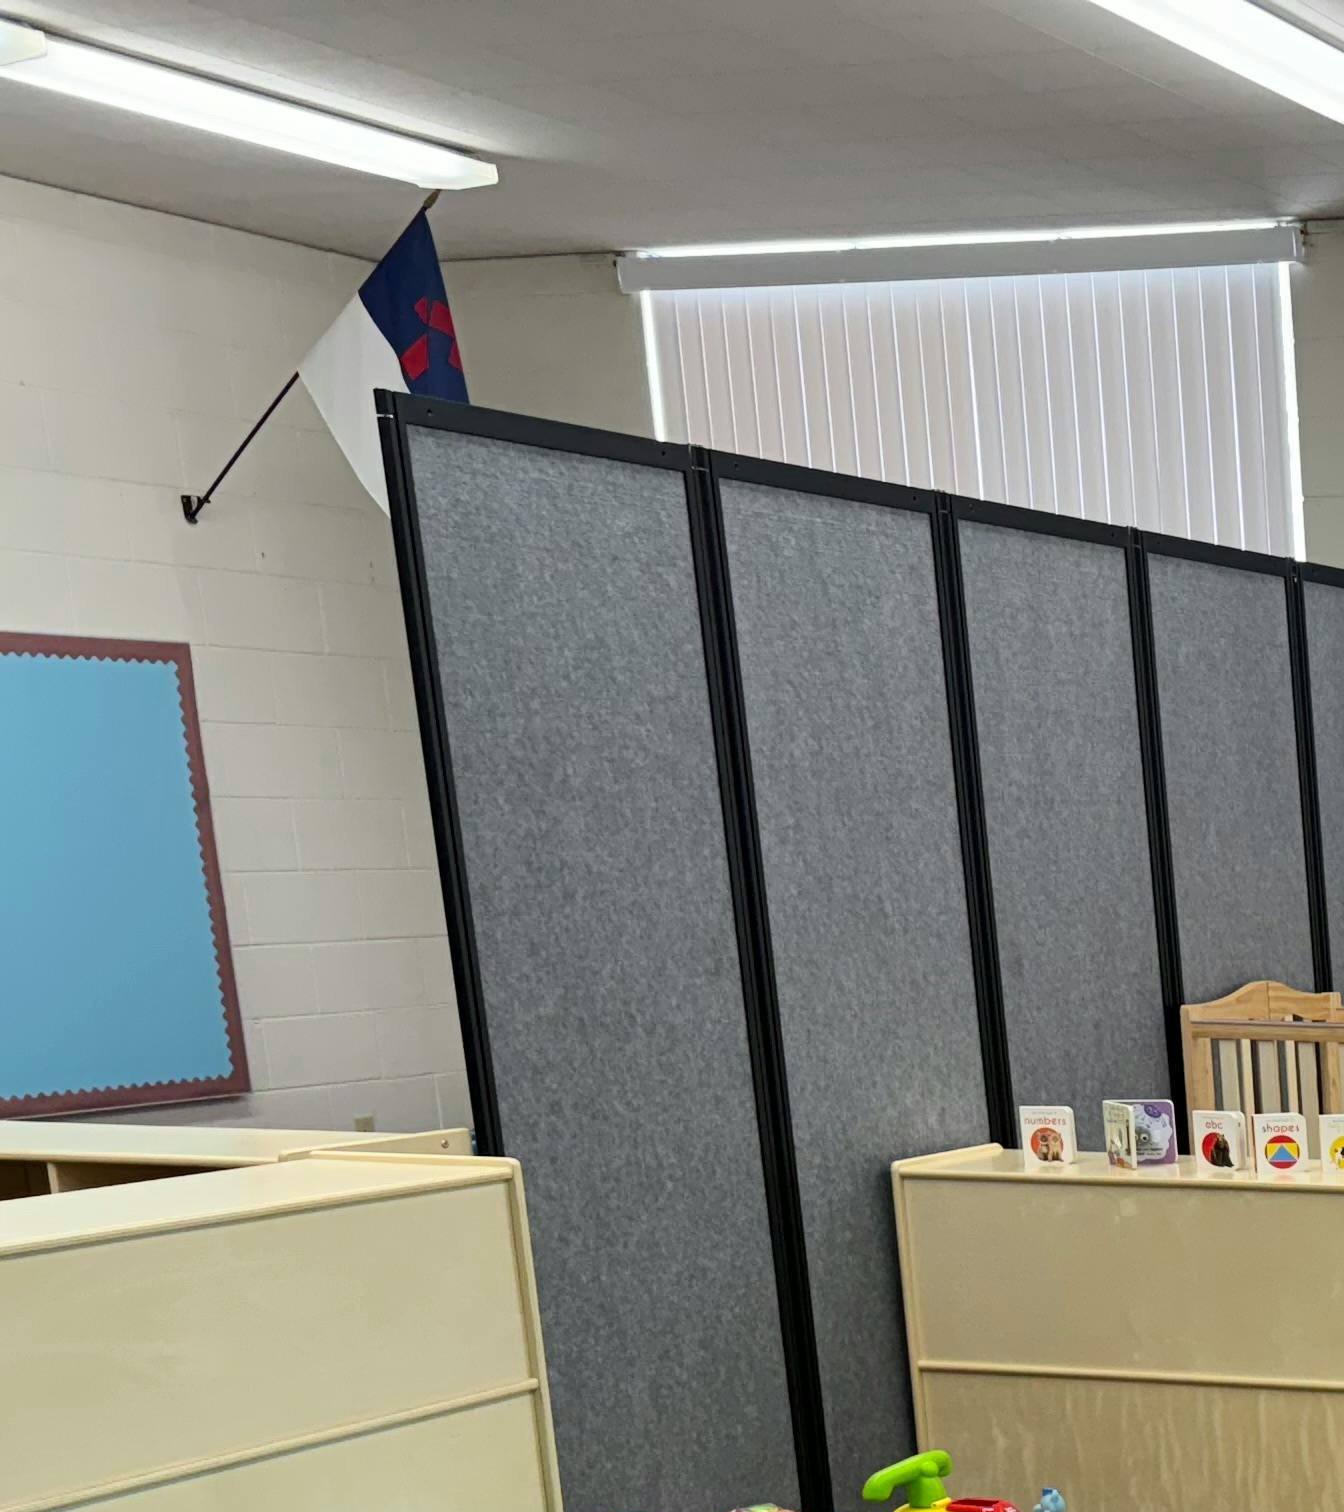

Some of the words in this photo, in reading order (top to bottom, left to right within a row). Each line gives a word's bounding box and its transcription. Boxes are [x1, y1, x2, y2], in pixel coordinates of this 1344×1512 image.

[1024, 1116, 1067, 1126] numbers
[1205, 1120, 1223, 1130] abc
[1261, 1123, 1300, 1133] shapes
